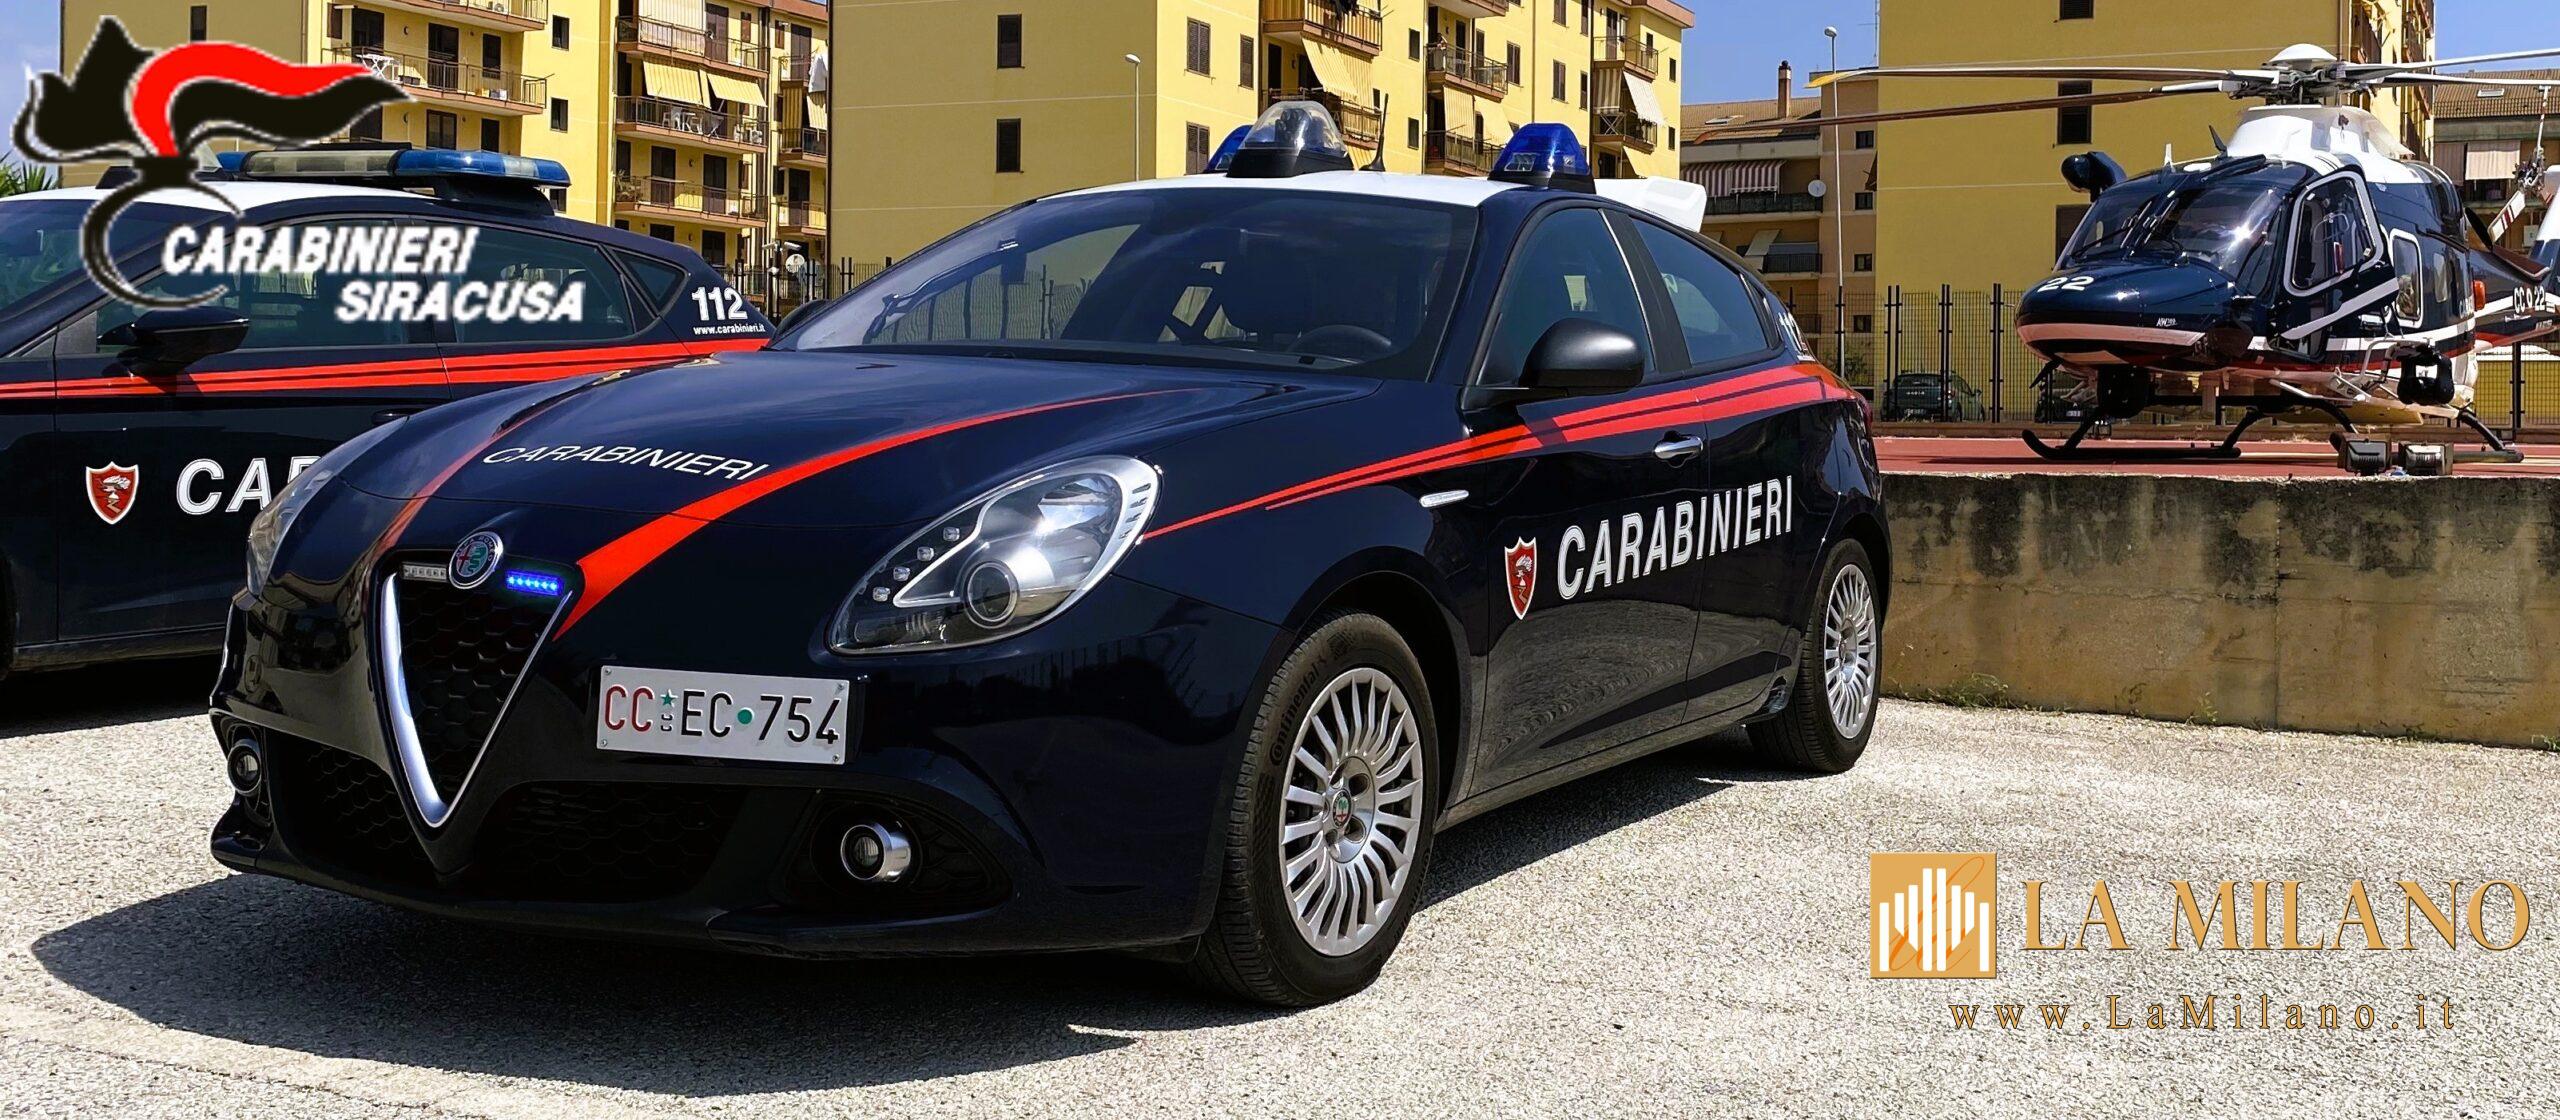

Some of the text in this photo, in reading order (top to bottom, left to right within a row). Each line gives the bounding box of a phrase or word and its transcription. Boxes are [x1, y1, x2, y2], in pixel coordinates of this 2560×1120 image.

[2037, 276, 2094, 293] 22
[2514, 286, 2525, 314] CC
[692, 286, 748, 321] 112
[693, 323, 766, 335] www.carabinieri.it
[483, 445, 770, 481] CARABINIERI
[1557, 475, 1792, 600] CARABINIERI
[604, 685, 654, 732] CC
[680, 689, 733, 738] EC
[758, 694, 841, 745] 754
